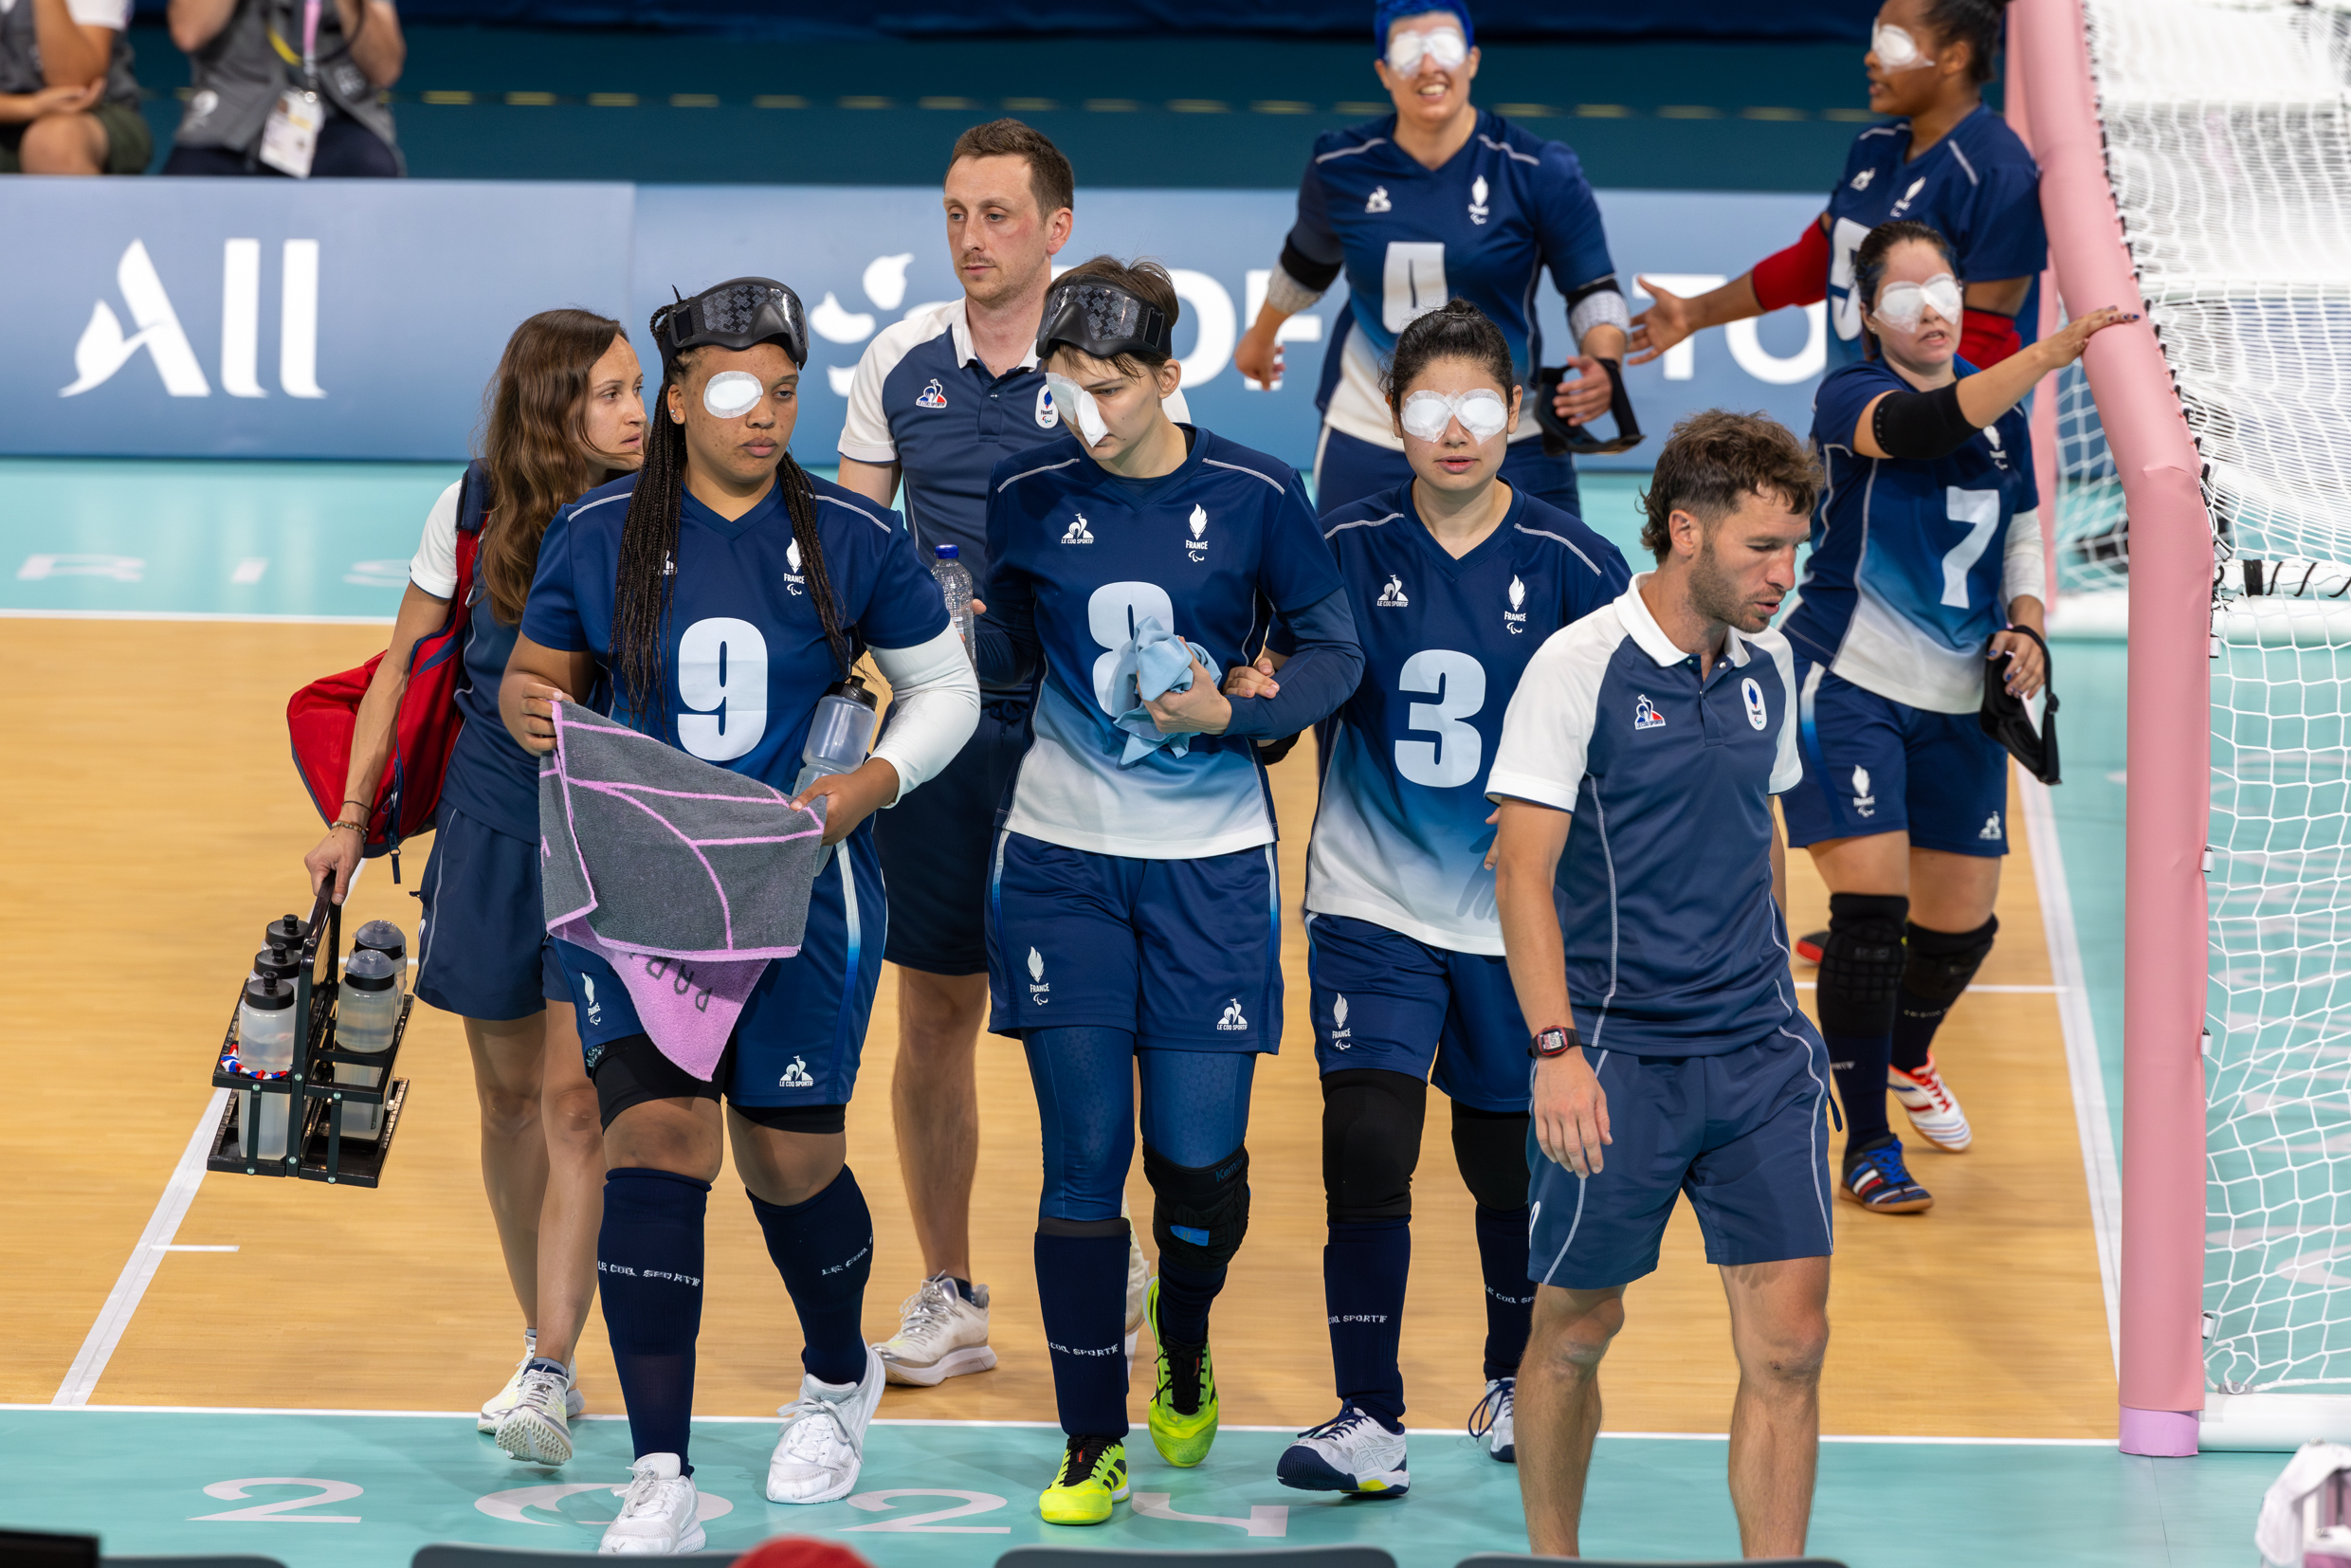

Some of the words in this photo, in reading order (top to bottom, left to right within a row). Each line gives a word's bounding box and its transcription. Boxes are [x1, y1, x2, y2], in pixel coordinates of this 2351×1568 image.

[1185, 539, 1209, 550] FRANCE
[1940, 485, 2000, 610] 7
[783, 573, 805, 584] FRANCE
[1504, 611, 1526, 622] FRANCE
[1088, 581, 1175, 719] 8
[678, 617, 769, 761] 9
[1394, 649, 1486, 788] 3
[1030, 983, 1049, 994] FRANCE
[588, 1002, 601, 1017] FRANCE
[1332, 1028, 1351, 1039] FRANCE
[1496, 1293, 1517, 1304] COQ
[1342, 1314, 1388, 1323] SPORTIF
[1049, 1342, 1070, 1354] COQ
[1072, 1343, 1119, 1357] SPORTIF
